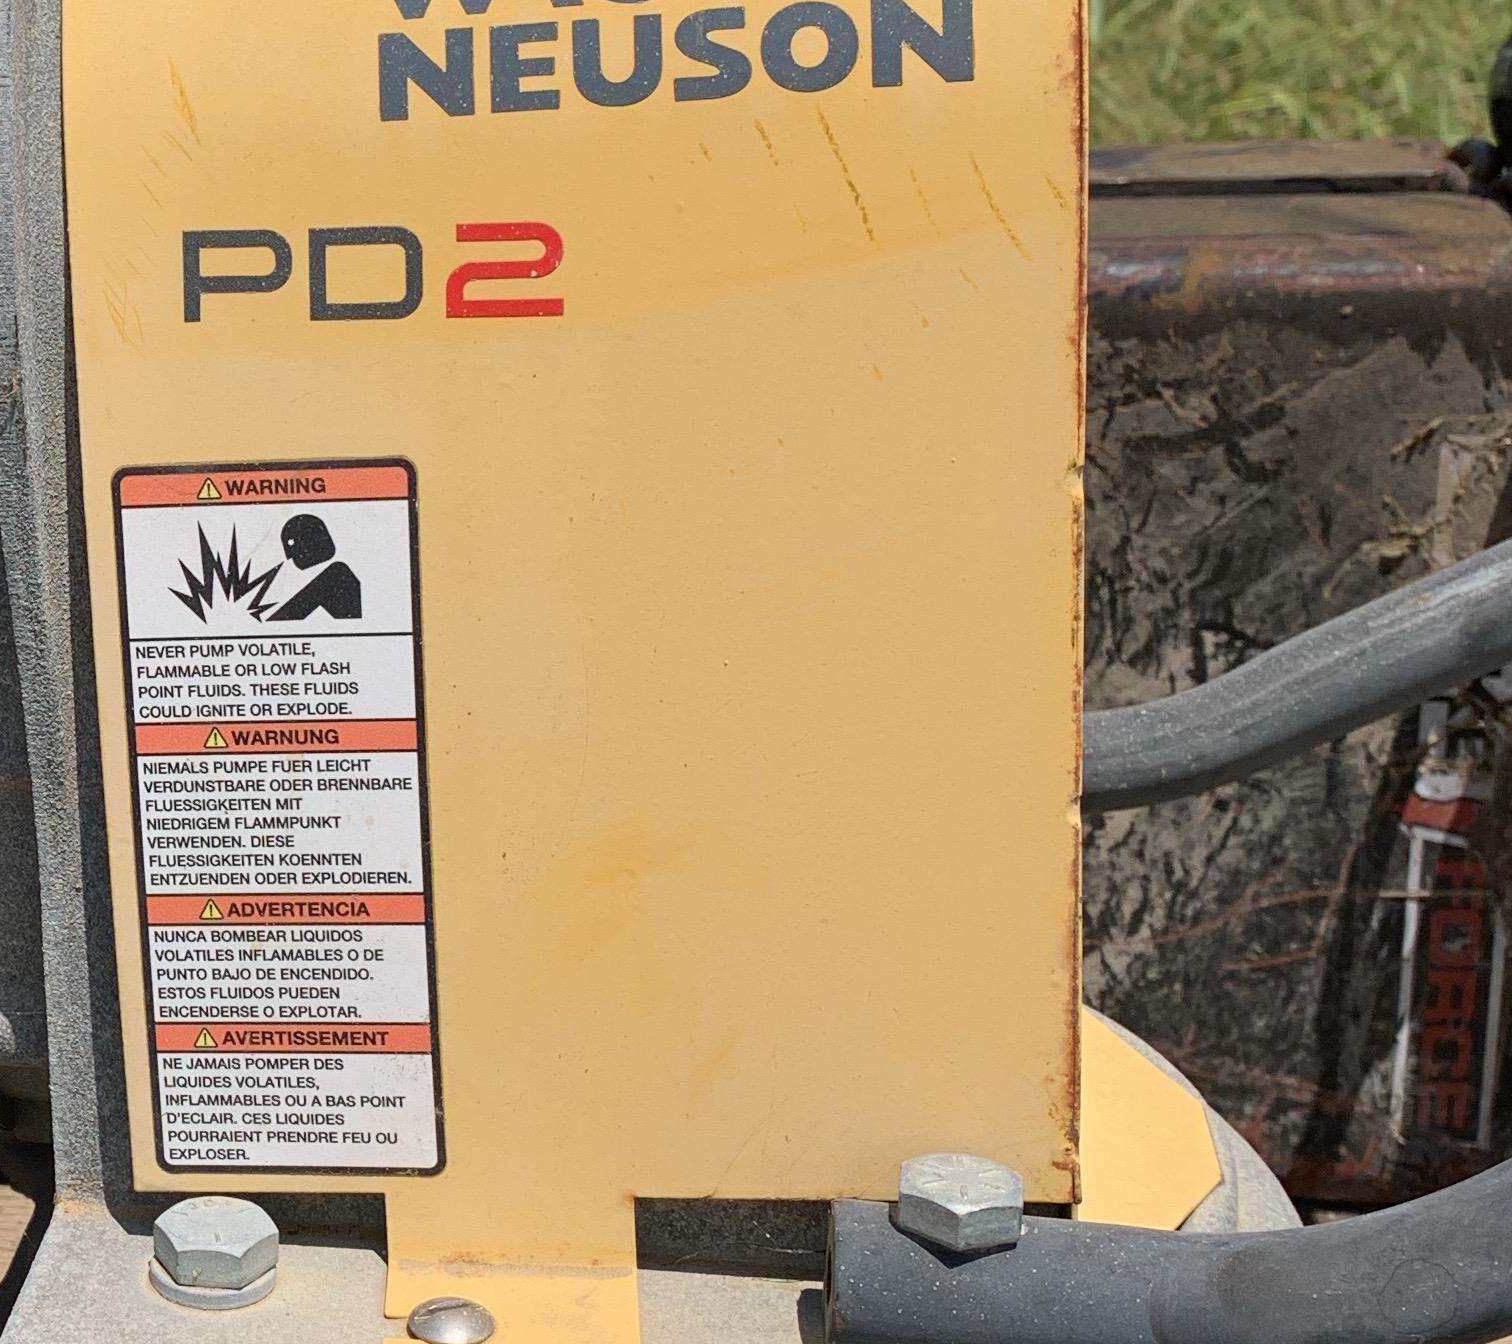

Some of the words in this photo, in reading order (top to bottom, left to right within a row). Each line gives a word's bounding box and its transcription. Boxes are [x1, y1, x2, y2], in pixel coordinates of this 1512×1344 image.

[182, 222, 566, 324] PD2
[225, 477, 327, 496] WARNING
[135, 645, 185, 659] NEVER
[190, 644, 234, 658] PUMP
[238, 642, 316, 658] VOLATILE,
[137, 663, 231, 679] FLAMMABLE
[234, 663, 258, 677] OR
[261, 662, 297, 677] LOW
[301, 661, 351, 676] FLASH
[138, 685, 184, 699] POINT
[188, 684, 245, 698] FLUIDS.
[249, 683, 300, 697] THESE
[303, 681, 359, 696] FLUIDS
[139, 705, 192, 719] COULD
[196, 704, 245, 718] IGNITE
[249, 703, 273, 717] OR
[277, 702, 353, 716] EXPLODE.
[231, 729, 340, 746] WARNUNG
[143, 761, 209, 776] NIEMALS
[213, 760, 268, 774] PUMPE
[272, 760, 313, 773] FUER
[316, 759, 371, 772] LEICHT
[144, 779, 265, 794] VERDUNSTBARE
[269, 778, 313, 792] ODER
[317, 777, 413, 791] BRENNBARE
[145, 798, 272, 812] FLUESSIGKEITEN
[275, 798, 303, 811] MIT
[146, 817, 230, 830] NIEDRIGEM
[235, 816, 342, 829] FLAMMPUNKT
[147, 836, 247, 849] VERWENDEN.
[250, 835, 295, 848] DIESE
[149, 854, 275, 868] FLUESSIGKEITEN
[279, 853, 362, 866] KOENNTEN
[150, 873, 250, 886] ENTZUENDEN
[254, 872, 298, 885] ODER
[302, 871, 412, 885] EXPLODIEREN.
[227, 902, 370, 918] ADVERTENCIA
[153, 930, 207, 943] NUNCA
[211, 930, 287, 943] BOMBEAR
[291, 929, 363, 943] LIQUIDOS
[155, 949, 234, 962] VOLATILES
[238, 949, 344, 962] INFLAMABLES
[349, 949, 361, 962] O
[364, 949, 385, 962] DE
[156, 968, 208, 981] PUNTO
[212, 968, 251, 981] BAJO
[256, 968, 277, 981] DE
[280, 967, 374, 981] ENCENDIDO.
[158, 987, 206, 1000] ESTOS
[210, 987, 274, 1000] FLUIDOS
[279, 987, 340, 1000] PUEDEN
[159, 1005, 260, 1019] ENCENDERSE
[263, 1005, 275, 1019] O
[279, 1006, 362, 1019] EXPLOTAR.
[222, 1031, 389, 1046] AVERTISSEMENT
[163, 1057, 183, 1070] NE
[186, 1057, 241, 1070] JAMAIS
[245, 1057, 310, 1070] POMPER
[313, 1058, 344, 1071] DES
[164, 1075, 232, 1089] LIQUIDES
[236, 1076, 320, 1091] VOLATILES,
[165, 1094, 281, 1108] INFLAMMABLES
[284, 1094, 307, 1108] OU
[312, 1095, 322, 1108] A
[326, 1095, 357, 1108] BAS
[360, 1095, 406, 1109] POINT
[167, 1112, 238, 1125] D'ECLAIR.
[242, 1112, 272, 1126] CES
[276, 1113, 345, 1127] LIQUIDES
[168, 1130, 263, 1144] POURRAIENT
[267, 1130, 339, 1144] PRENDRE
[342, 1131, 372, 1145] FEU
[375, 1132, 398, 1145] OU
[169, 1148, 250, 1161] EXPLOSER.
